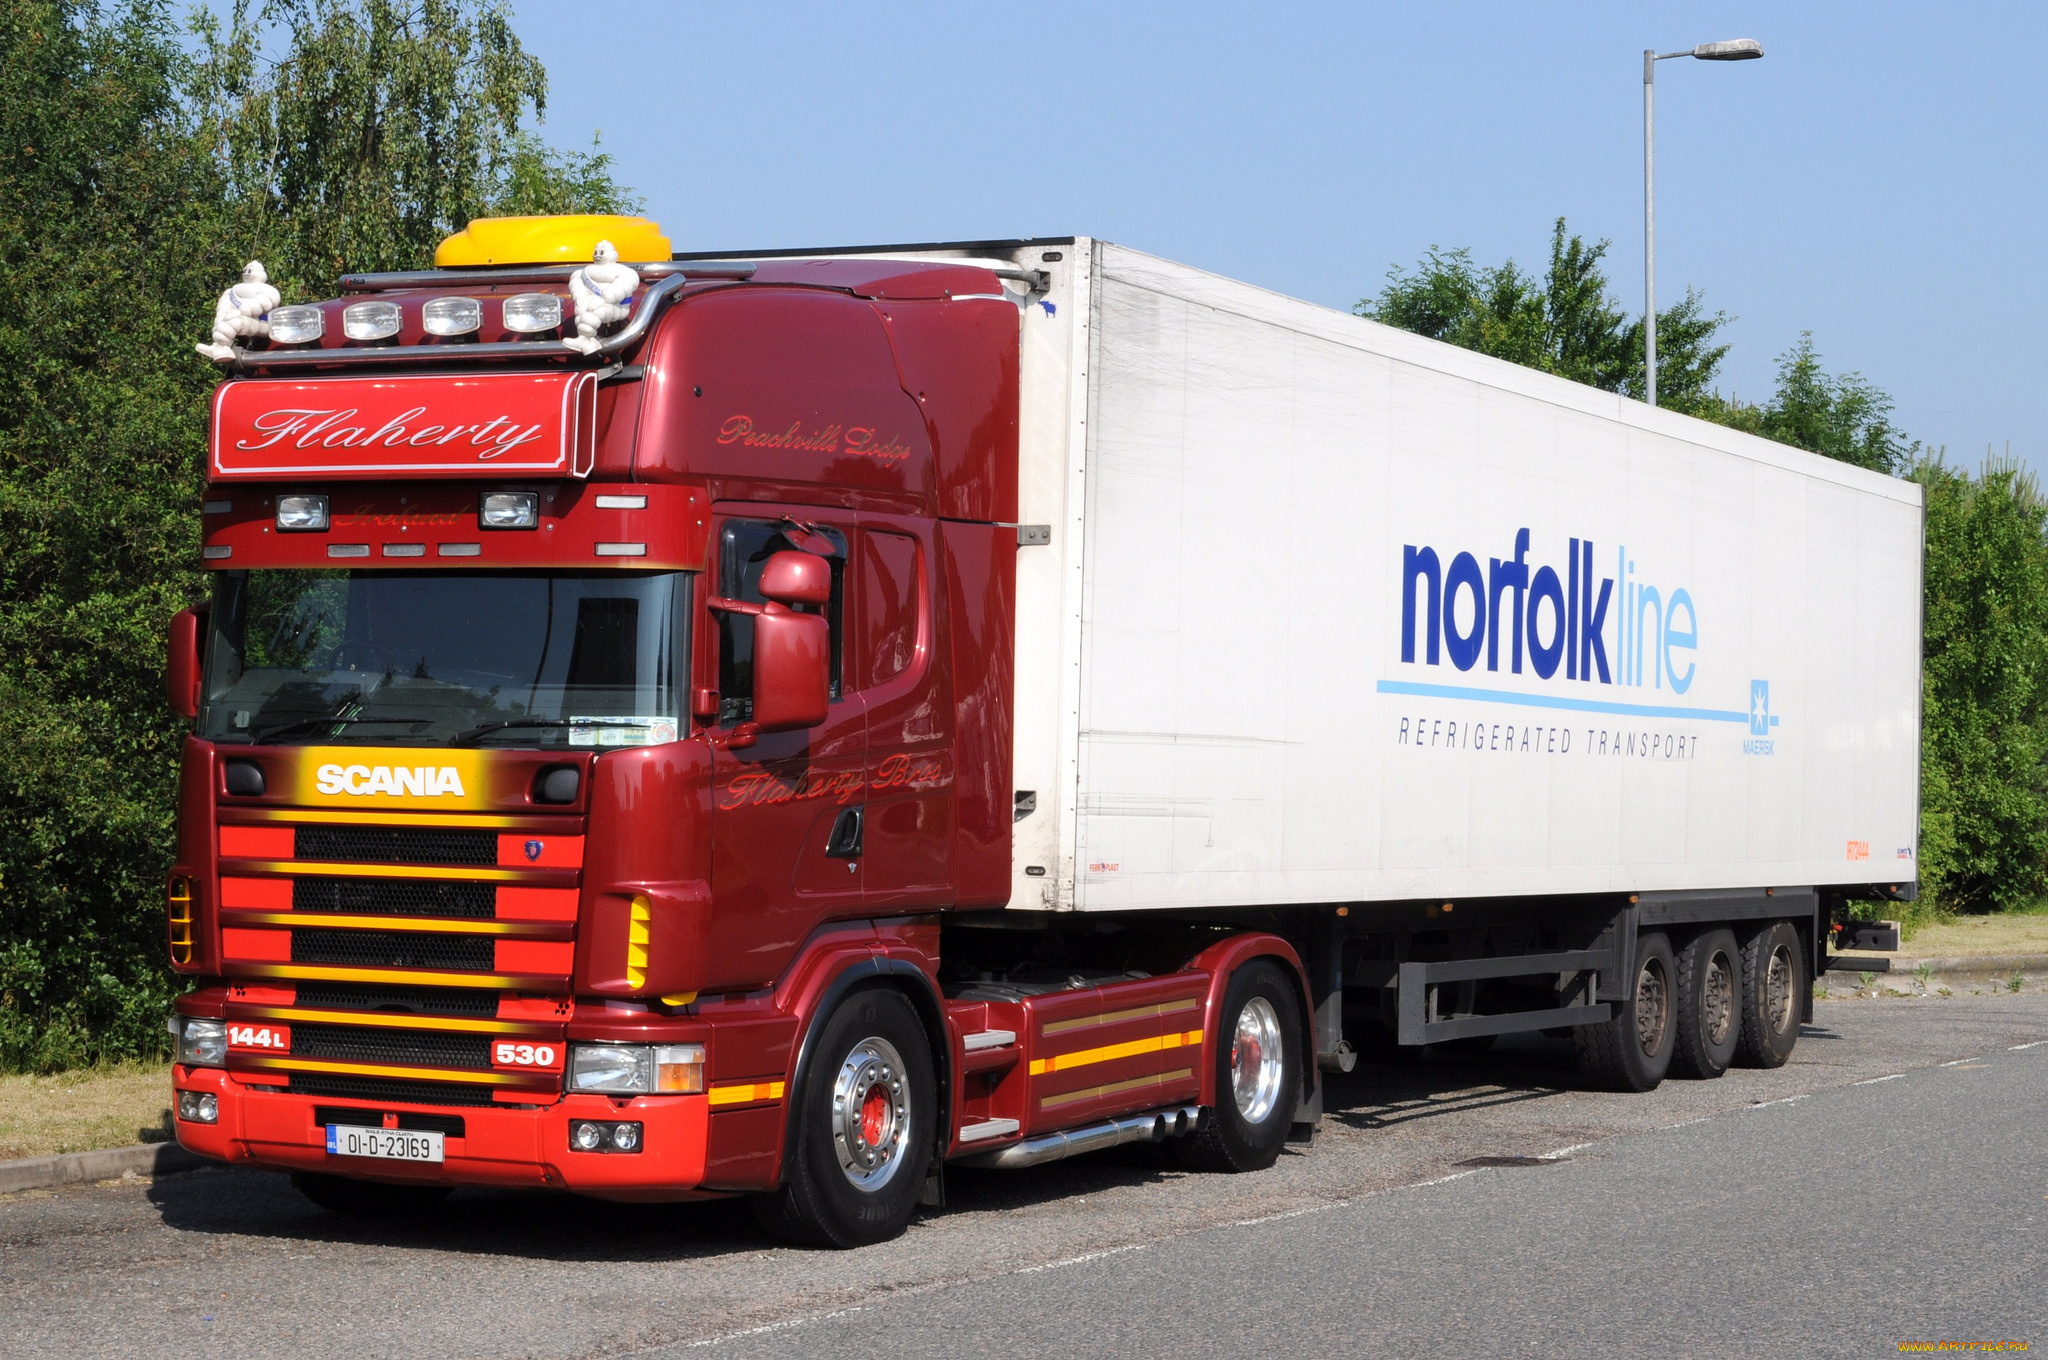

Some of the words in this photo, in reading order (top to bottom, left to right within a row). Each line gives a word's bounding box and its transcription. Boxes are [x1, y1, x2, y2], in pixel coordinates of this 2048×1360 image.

[236, 406, 543, 460] Flaherty
[844, 426, 912, 468] Lodge
[335, 504, 472, 527] Ireland
[1398, 717, 1571, 754] REFRIGERATED
[1587, 729, 1698, 760] TRANSPORT
[1743, 739, 1775, 756] MAERSK
[316, 764, 465, 797] SCANIA
[719, 766, 865, 811] Flaherty
[871, 753, 945, 789] Bros
[496, 1044, 555, 1066] 530
[348, 1133, 430, 1159] 01-D-23169
